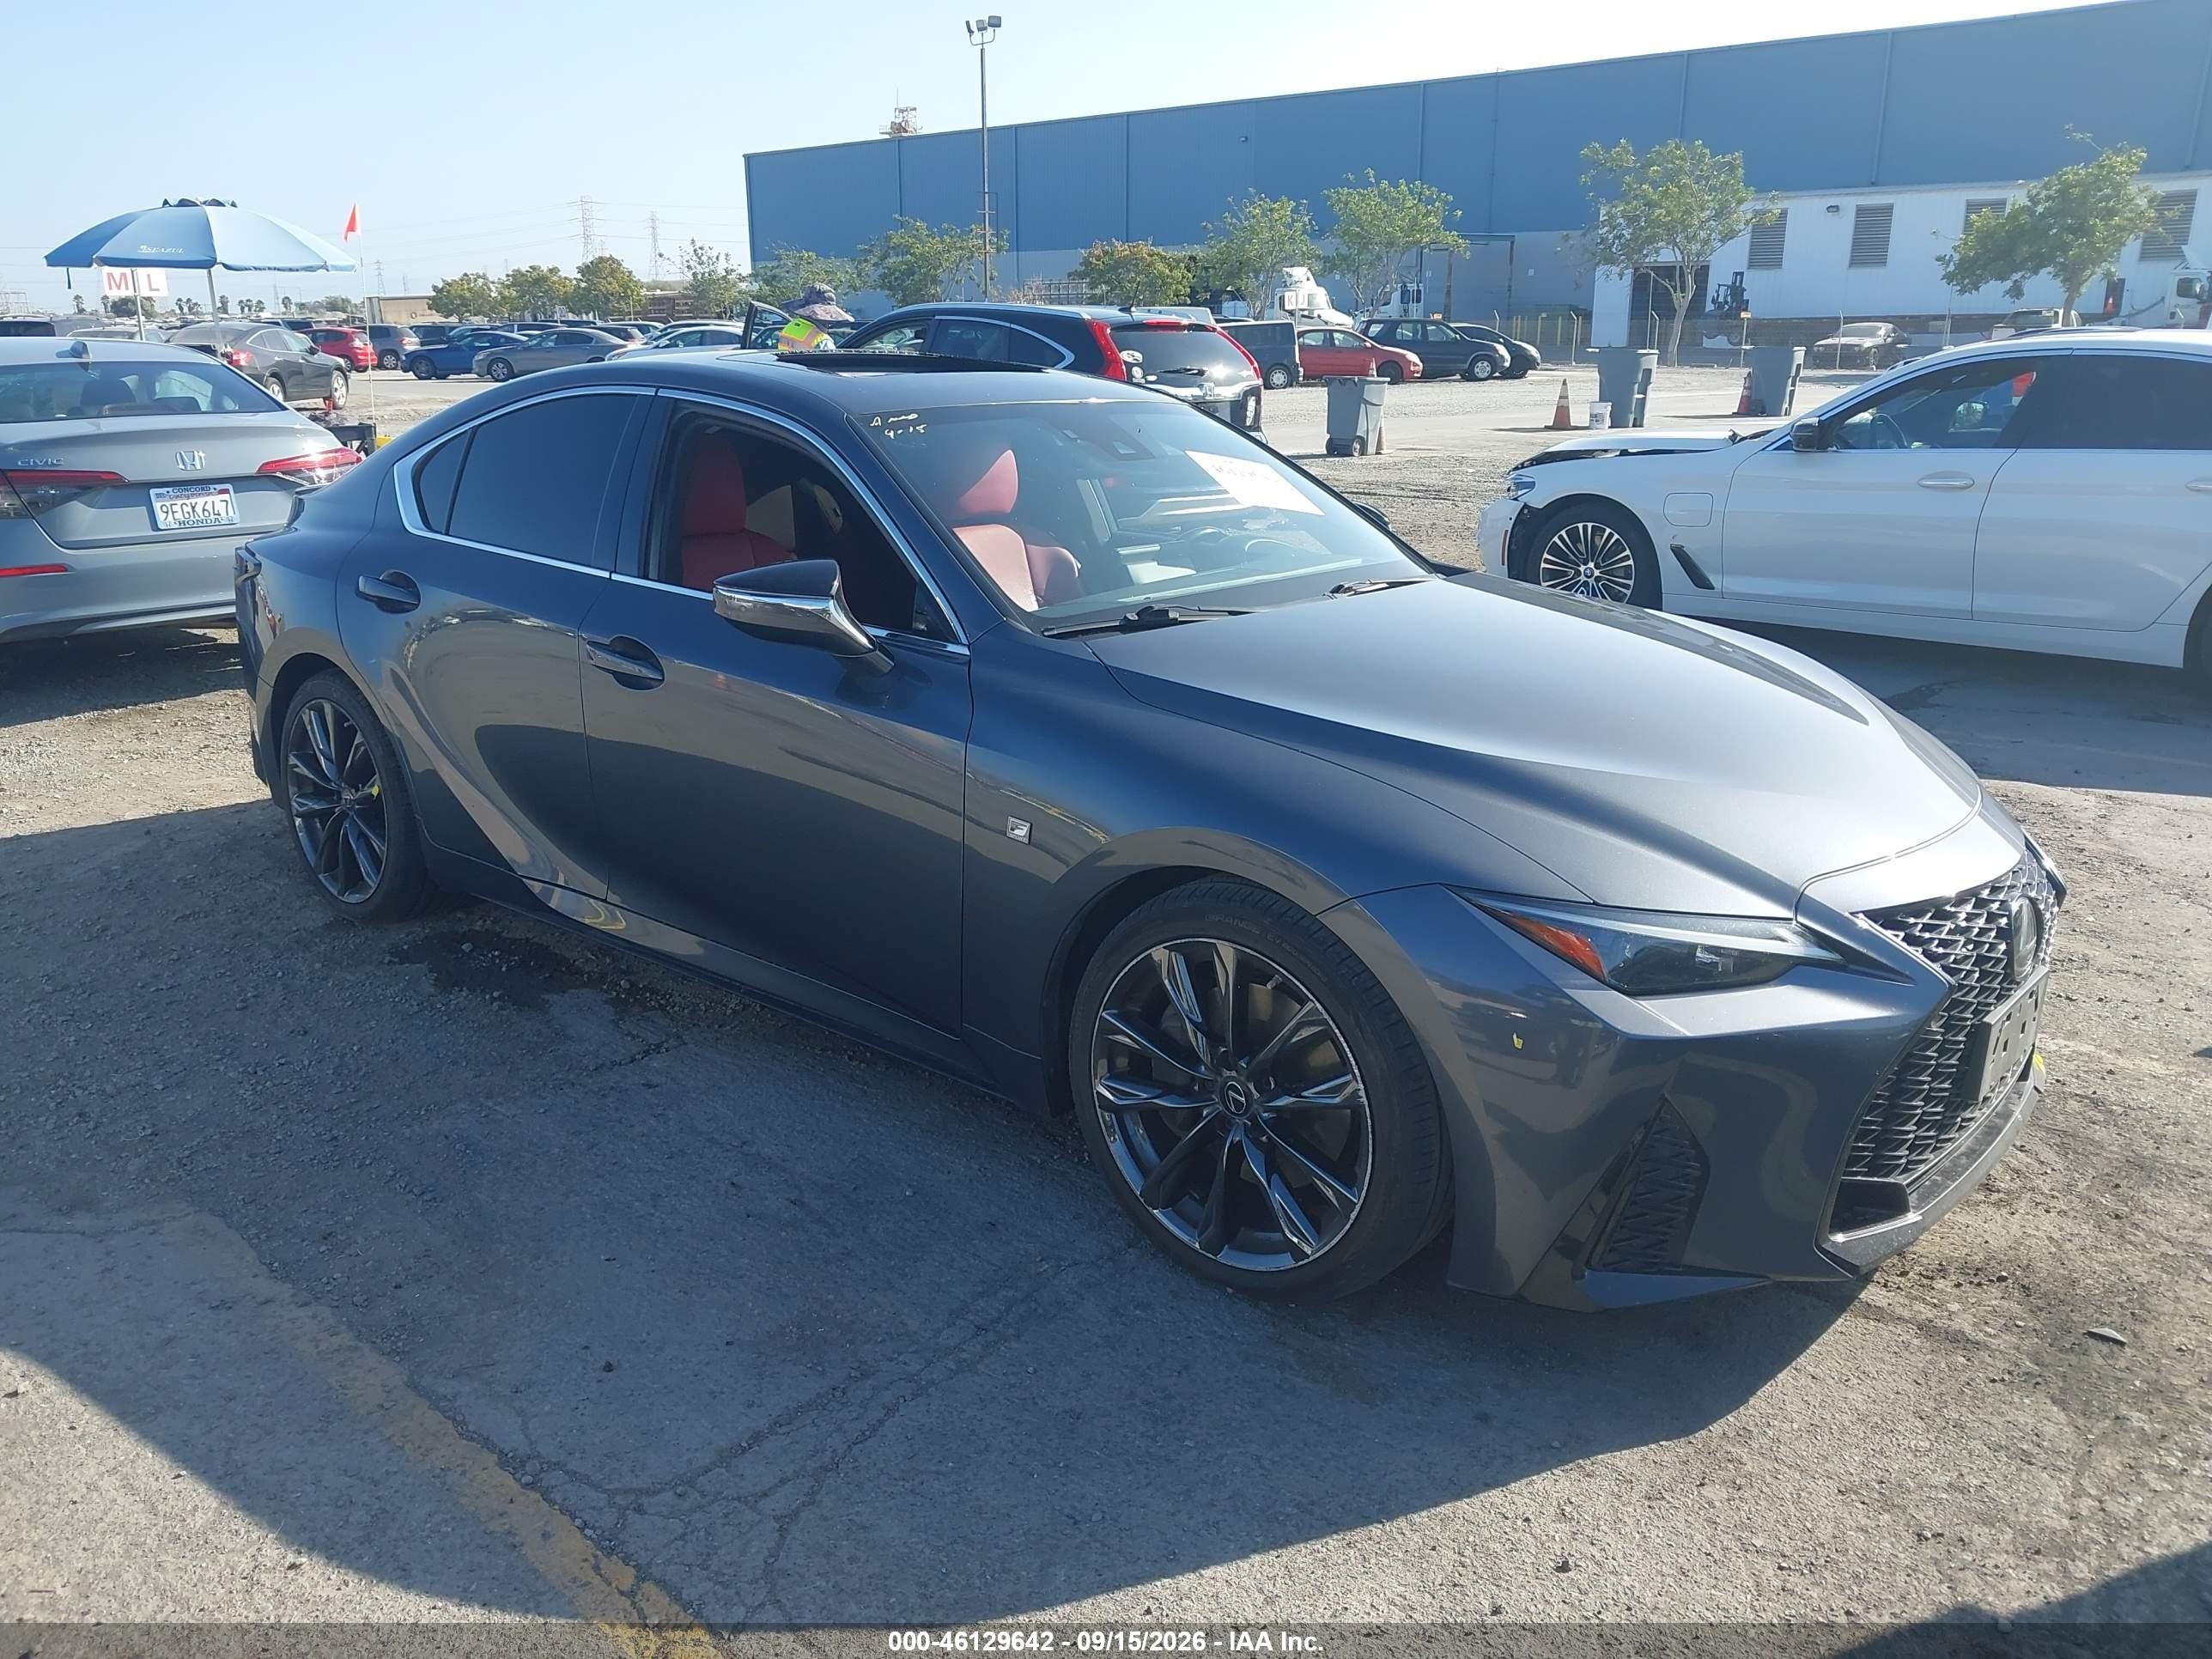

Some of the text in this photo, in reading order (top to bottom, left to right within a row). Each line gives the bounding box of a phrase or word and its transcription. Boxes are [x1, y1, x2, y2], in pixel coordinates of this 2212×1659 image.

[106, 272, 130, 290] M
[147, 273, 161, 292] L
[17, 458, 65, 466] CIVIC
[160, 500, 230, 522] 9EGK647
[178, 517, 222, 526] HONDA
